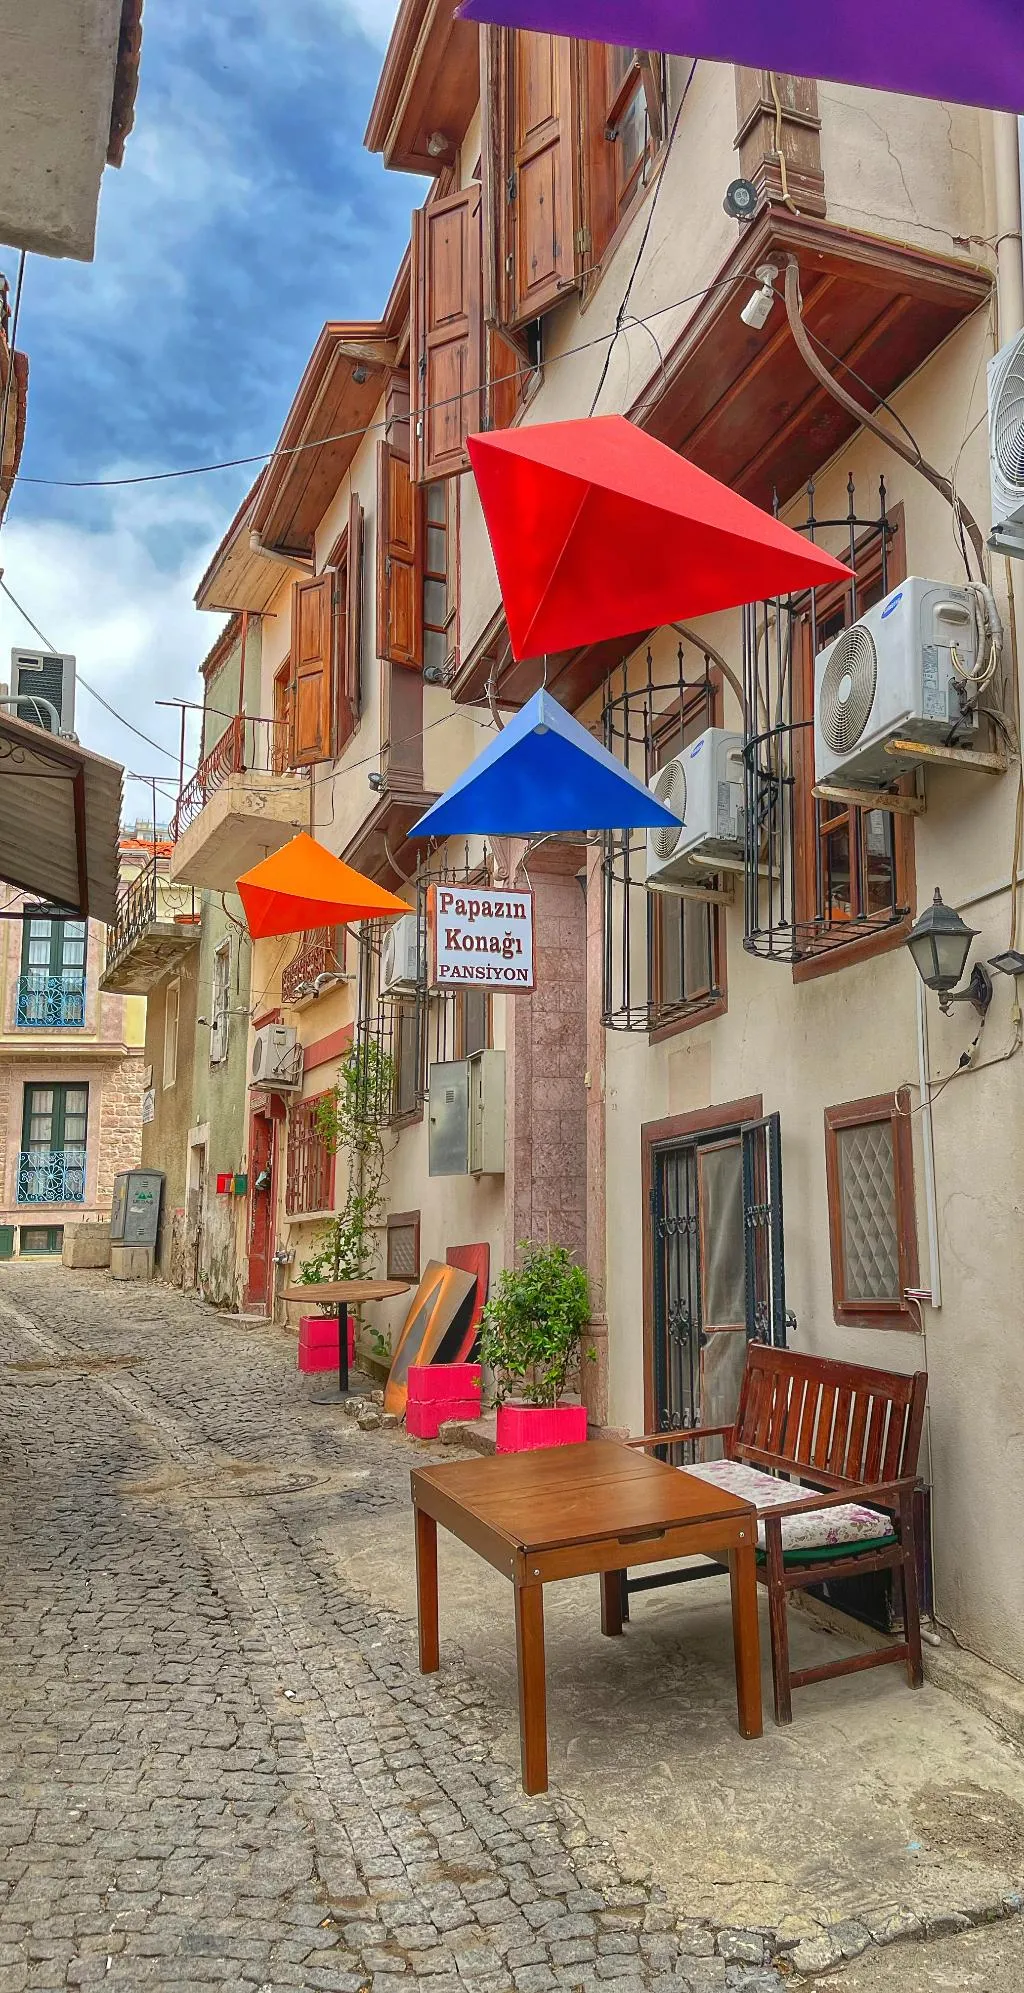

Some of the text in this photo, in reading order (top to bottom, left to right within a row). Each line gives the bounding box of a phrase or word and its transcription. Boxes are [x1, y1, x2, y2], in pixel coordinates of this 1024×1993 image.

[440, 893, 526, 922] Papazın
[445, 928, 522, 959] Konağı
[439, 963, 528, 981] PANSİYON
